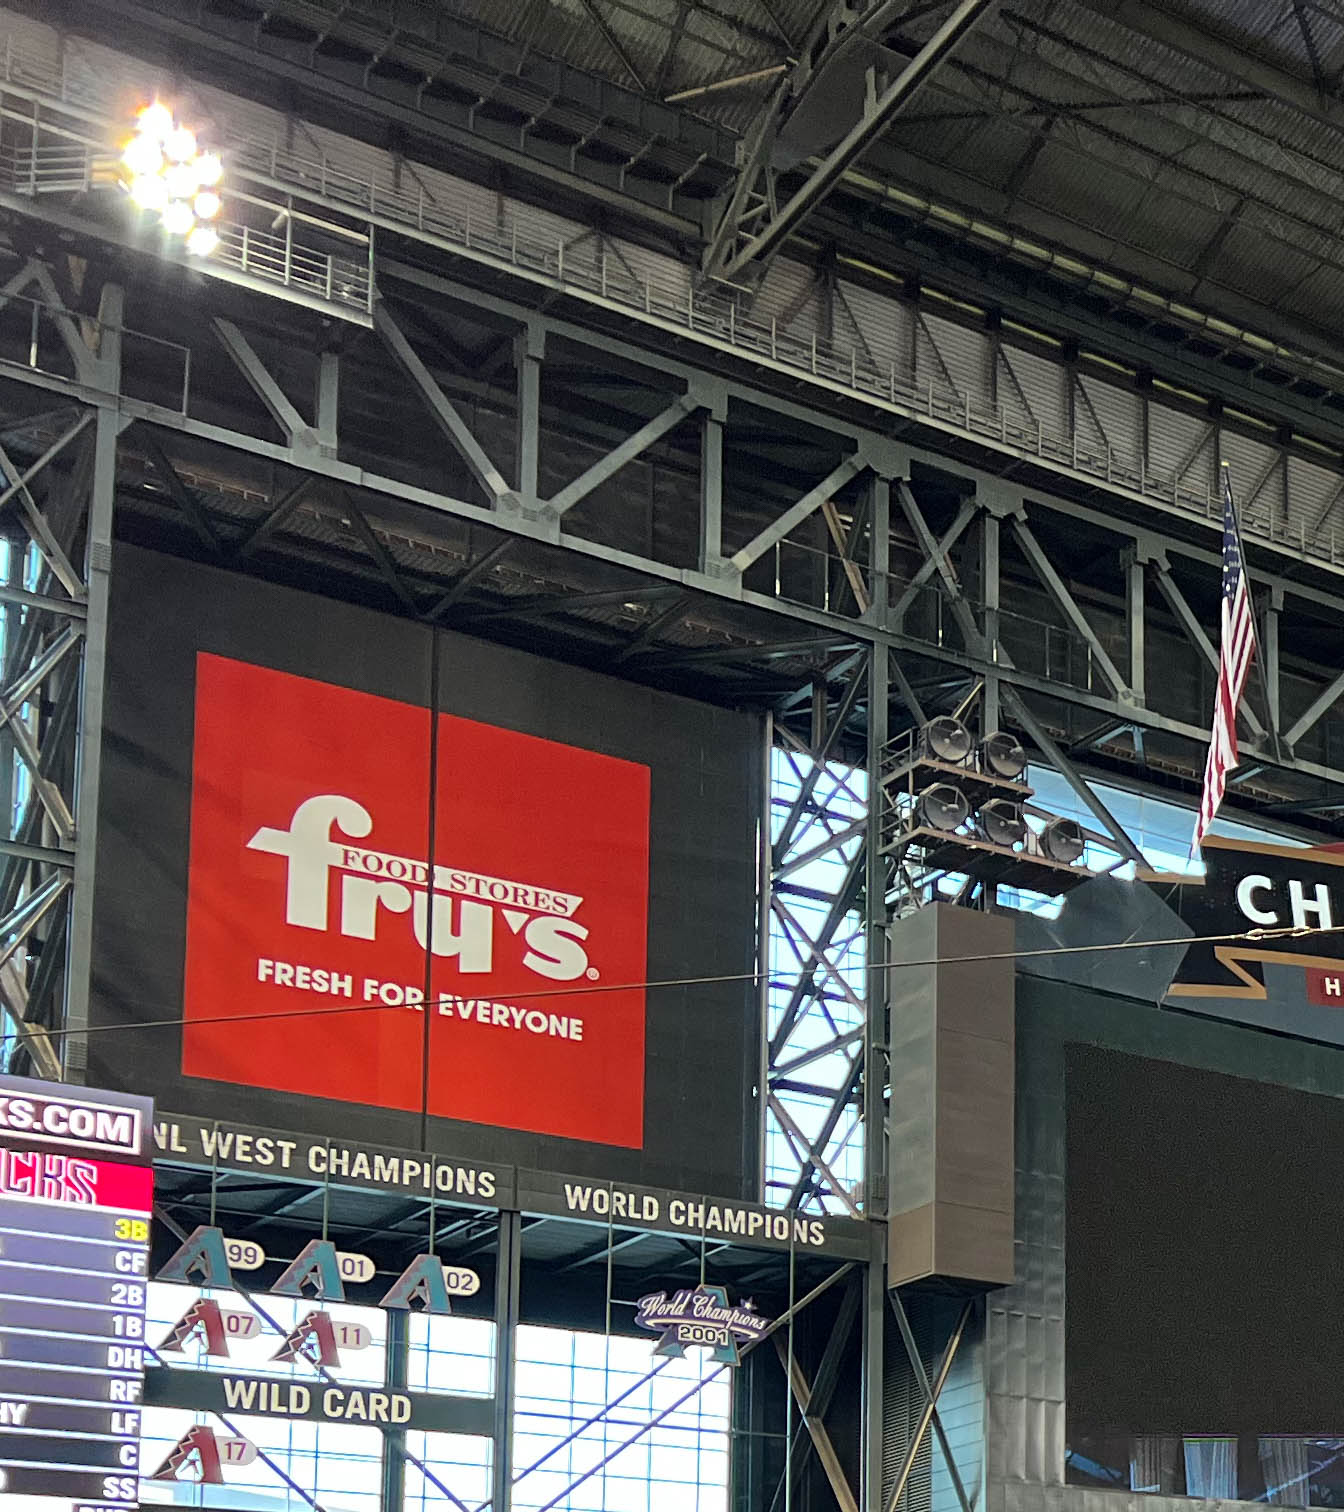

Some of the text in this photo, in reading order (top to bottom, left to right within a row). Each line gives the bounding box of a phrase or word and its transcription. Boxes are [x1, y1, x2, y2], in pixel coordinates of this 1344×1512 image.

[246, 794, 590, 982] fry's
[340, 847, 570, 915] FOOD STORES
[257, 958, 584, 1042] FRESH FOR EVERYONE
[200, 1129, 296, 1168] WEST
[307, 1145, 496, 1198] CHAMPIONS
[564, 1183, 825, 1246] WORLD CHAMPIONS
[114, 1218, 148, 1241] 3B
[115, 1252, 146, 1272] CF
[228, 1244, 259, 1265] 99
[341, 1257, 366, 1278] 01
[447, 1268, 474, 1291] 02
[111, 1284, 143, 1306] 2B
[639, 1289, 766, 1332] World Champions
[114, 1317, 143, 1338] 1B
[227, 1315, 253, 1335] 07
[339, 1325, 362, 1347] 11
[677, 1325, 729, 1346] 2001
[108, 1347, 142, 1369] DH
[110, 1381, 141, 1402] RF
[223, 1379, 412, 1423] WILD CARD
[112, 1412, 140, 1433] LF
[119, 1444, 137, 1466] C
[224, 1442, 247, 1461] 17
[103, 1476, 136, 1500] SS
